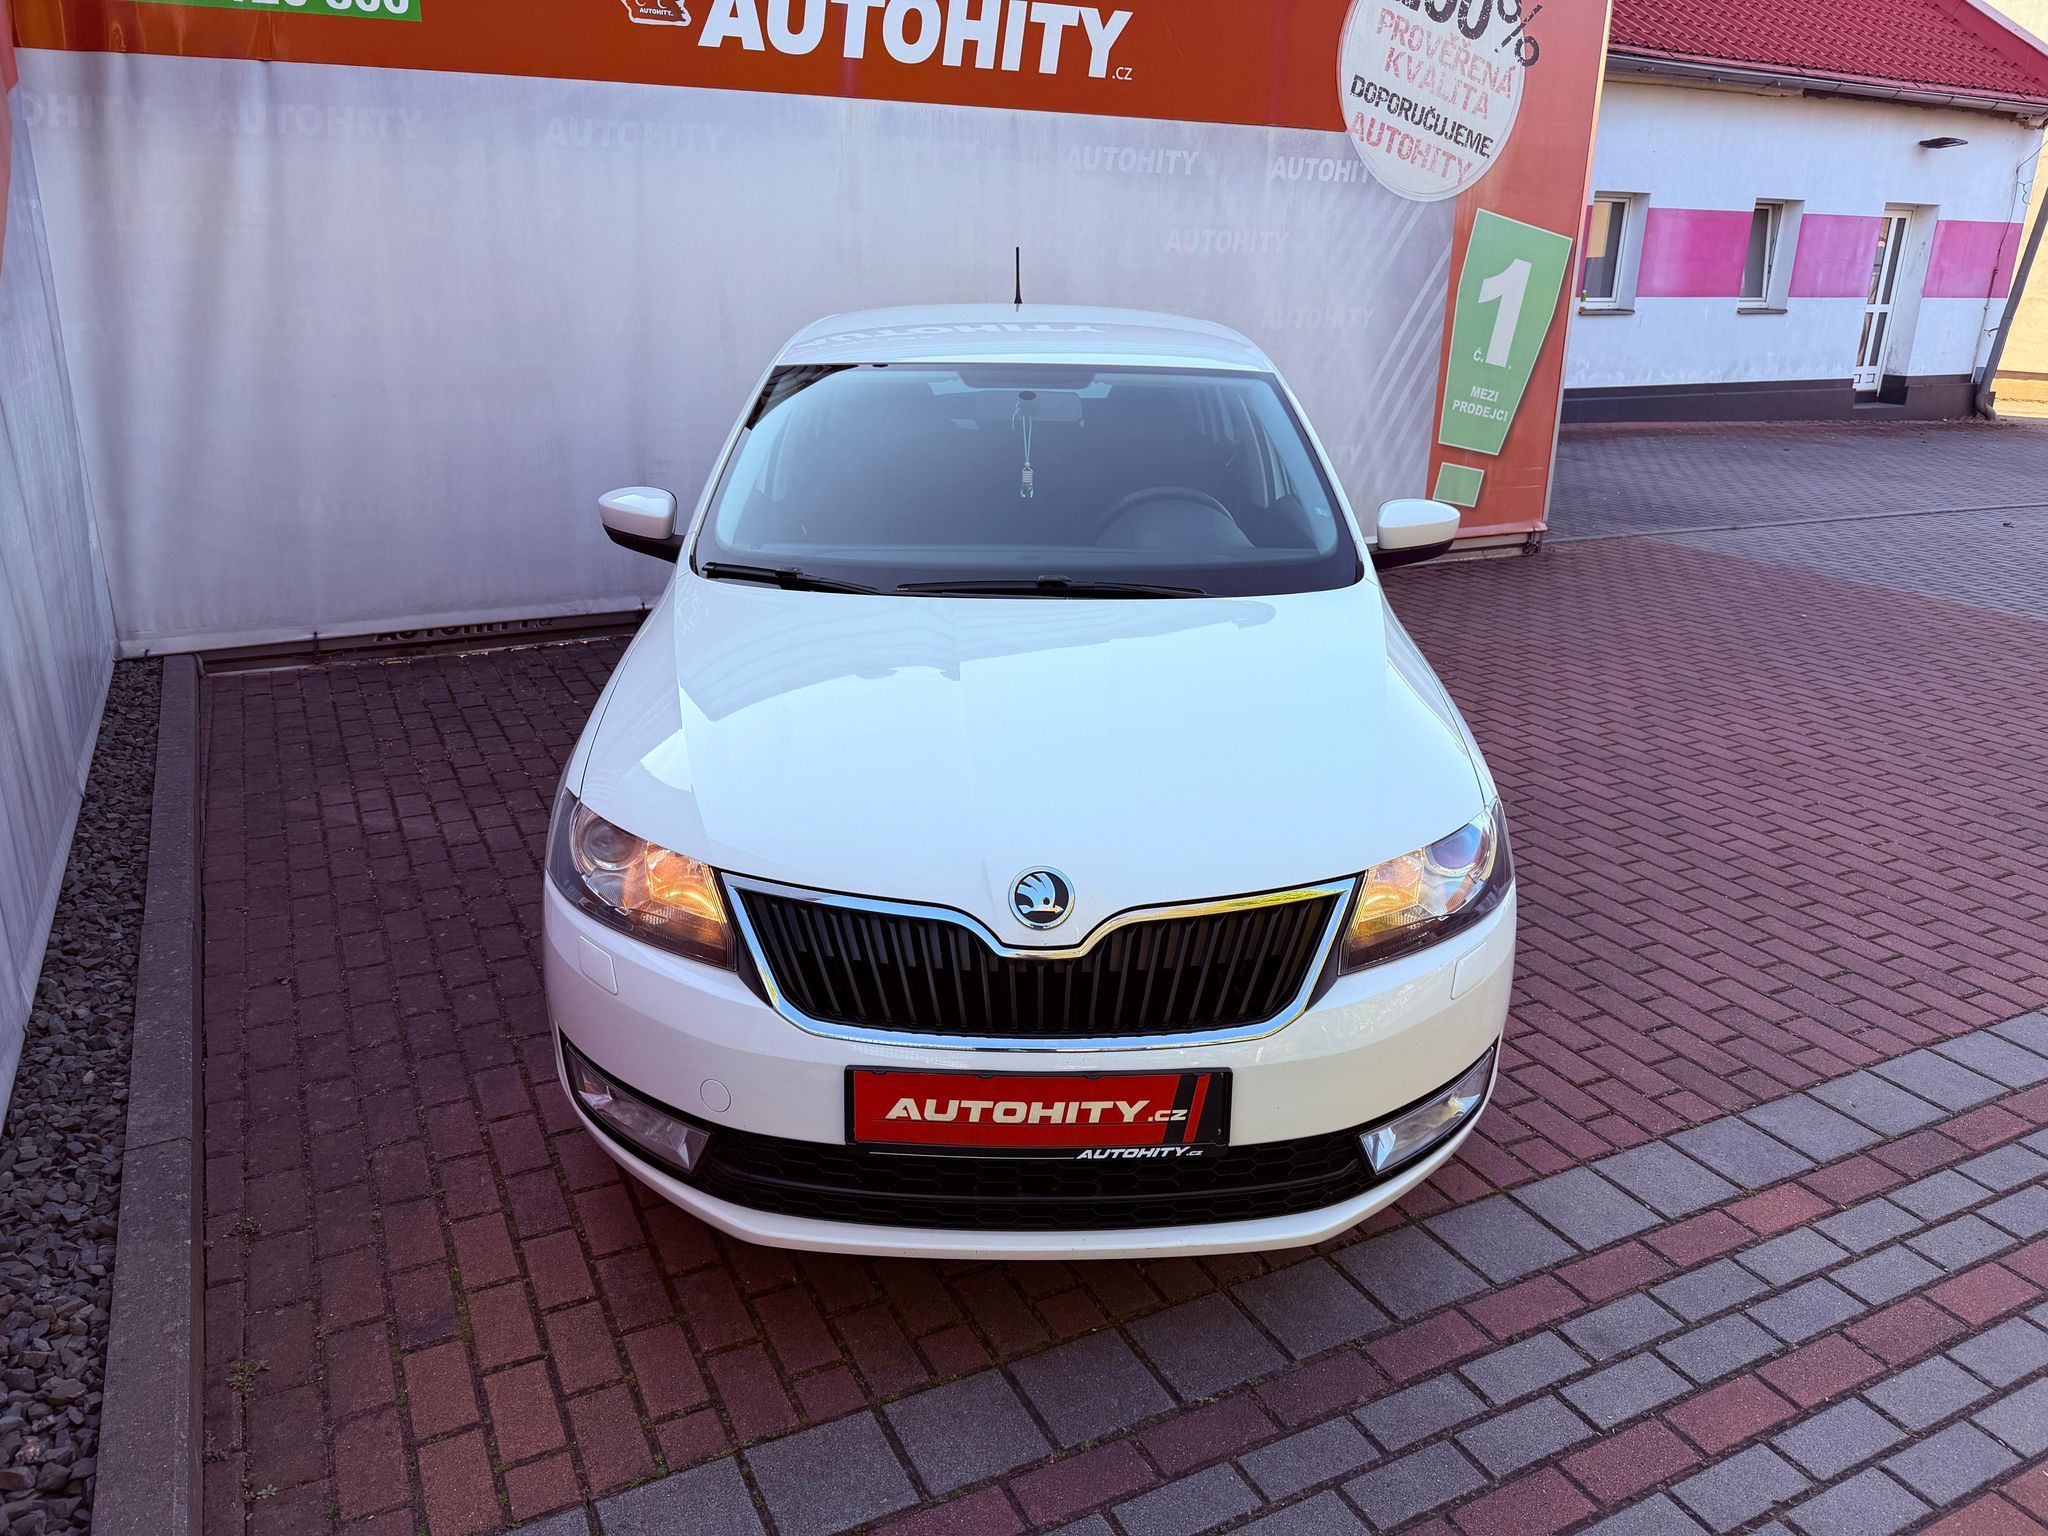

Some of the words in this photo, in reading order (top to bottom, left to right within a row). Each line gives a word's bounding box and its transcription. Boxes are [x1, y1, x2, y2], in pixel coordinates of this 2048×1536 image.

[1375, 8, 1516, 98] PROVĚŘENÁ
[1384, 47, 1488, 120] KVALITA
[1350, 74, 1493, 158] DOPORUČUJEME
[1067, 147, 1198, 175] AUTOHITY
[1350, 111, 1473, 185] AUTOHITY
[1270, 157, 1380, 183] AUTOHIT
[1166, 229, 1290, 255] AUTOHITY
[1470, 385, 1499, 403] MEZI
[1452, 399, 1509, 422] PRODEJCI
